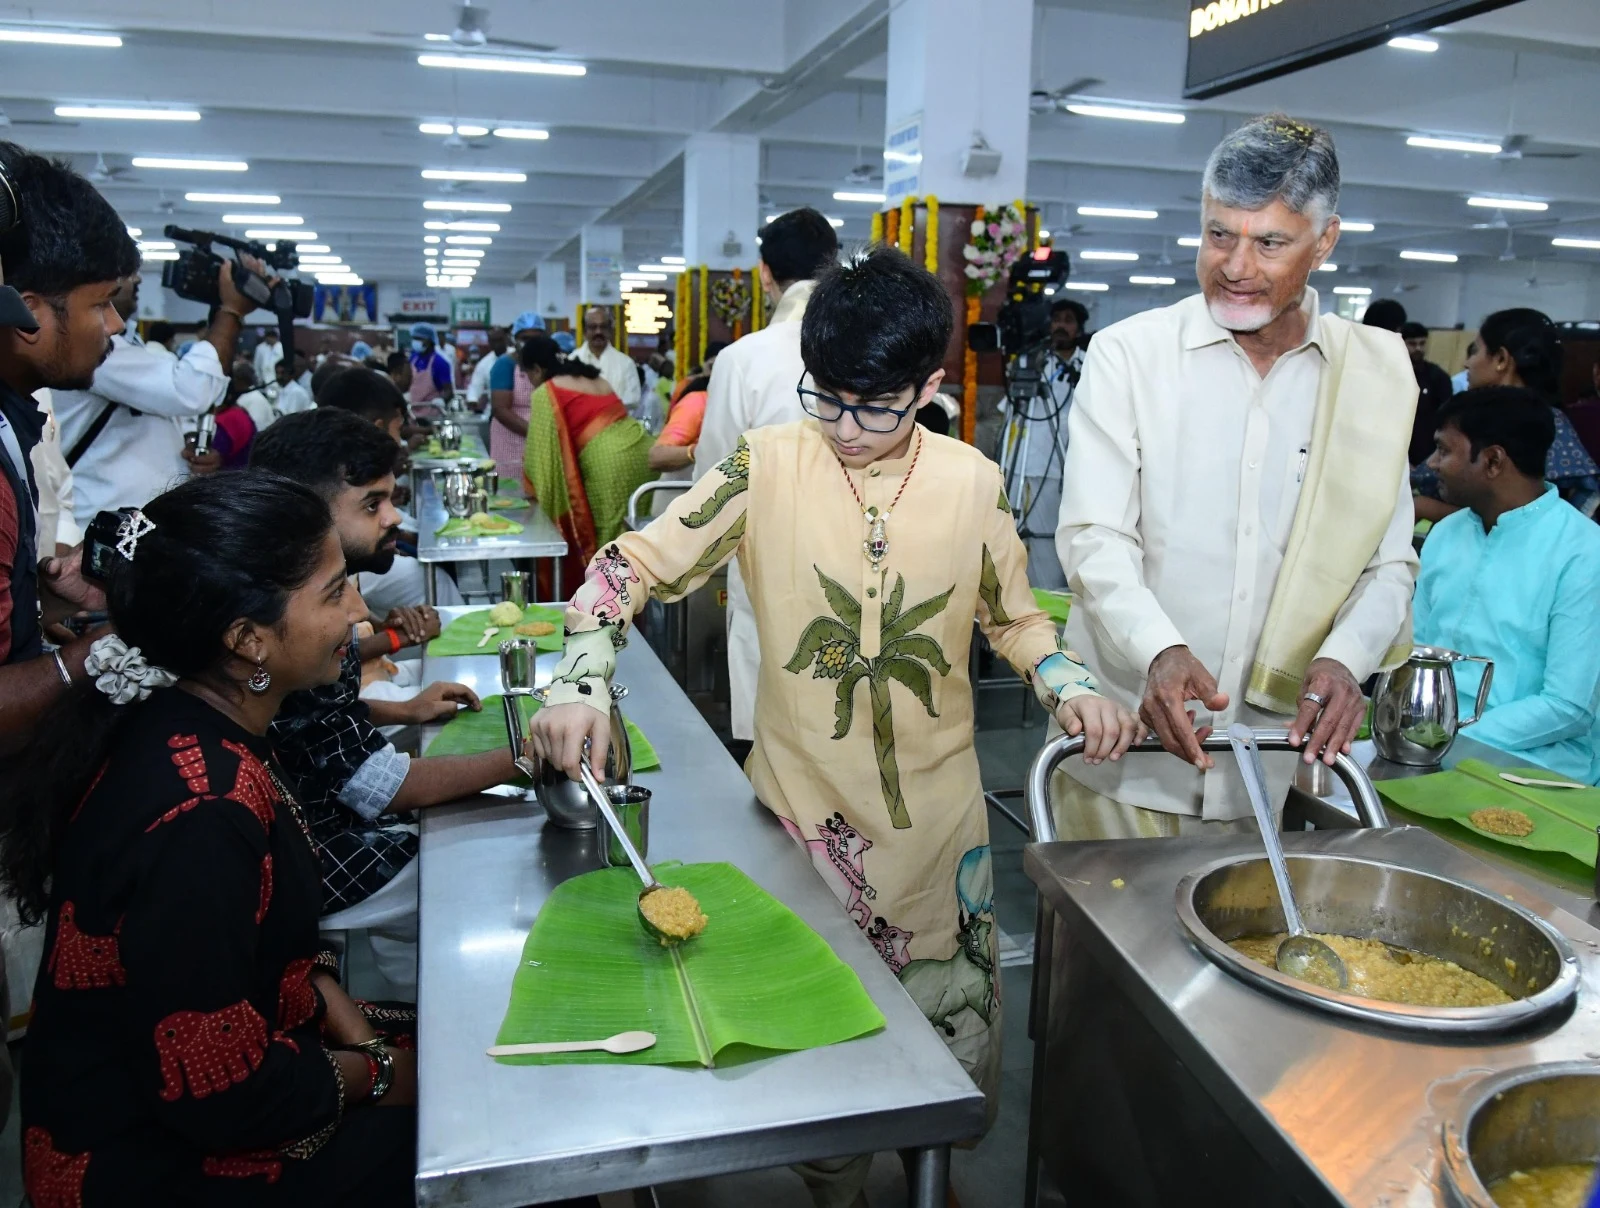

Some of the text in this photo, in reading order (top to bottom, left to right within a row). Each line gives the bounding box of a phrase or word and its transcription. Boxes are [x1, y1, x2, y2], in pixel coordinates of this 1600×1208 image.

[1190, 0, 1283, 38] DONA
[402, 301, 436, 312] EXIT
[456, 310, 486, 322] EXIT
